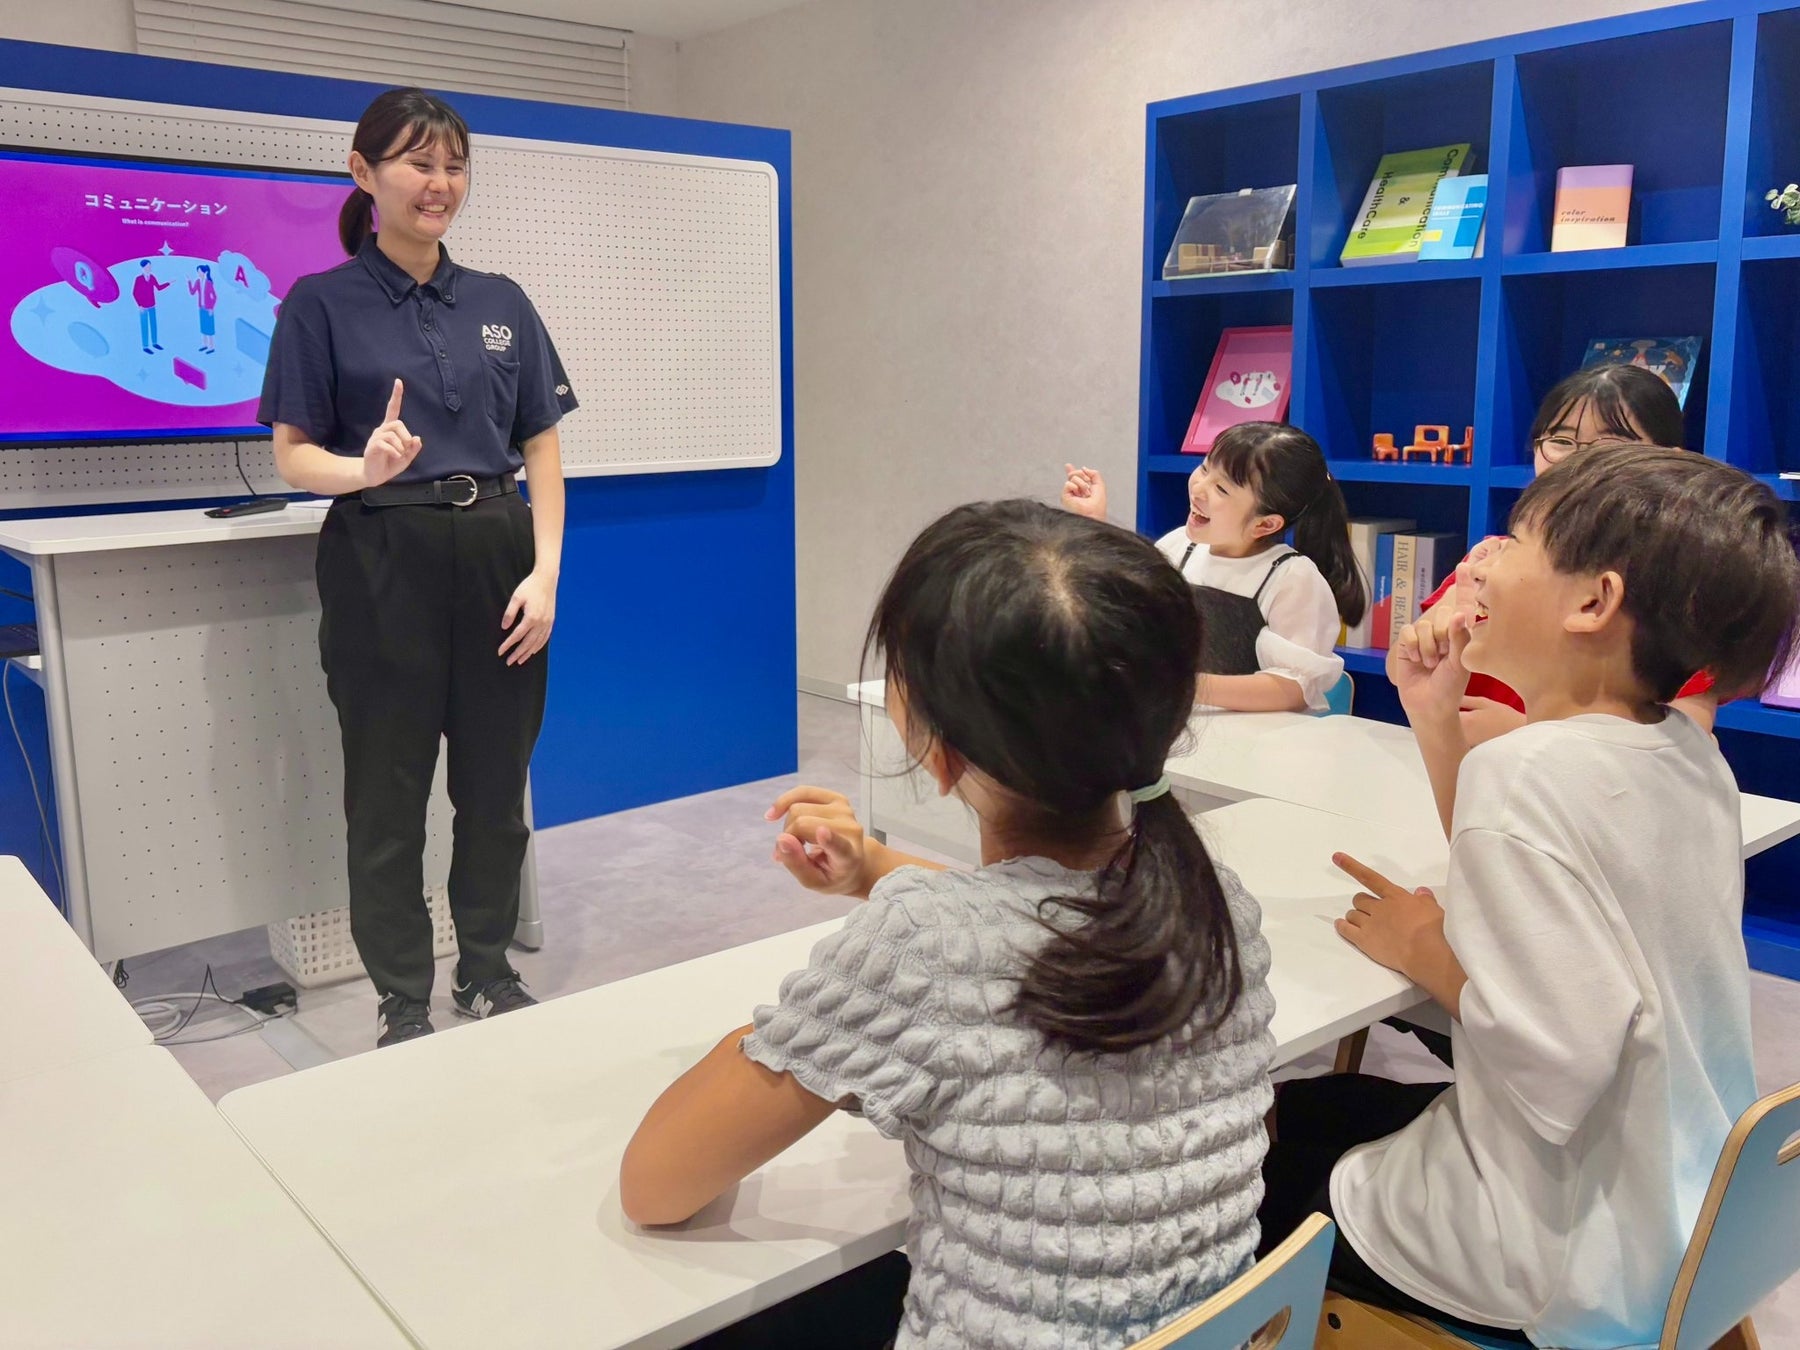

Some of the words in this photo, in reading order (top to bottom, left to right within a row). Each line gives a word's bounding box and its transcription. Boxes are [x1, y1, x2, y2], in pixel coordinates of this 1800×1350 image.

[84, 193, 228, 215] コミュニケーション
[1357, 171, 1395, 239] HealthCare
[1398, 196, 1410, 206] &
[235, 264, 249, 288] A
[482, 324, 512, 340] ASO
[483, 337, 512, 347] COLLEGE
[485, 344, 507, 352] GROUP
[1397, 541, 1408, 572] HAIR
[1396, 577, 1407, 590] &
[1391, 595, 1407, 643] BEAU
